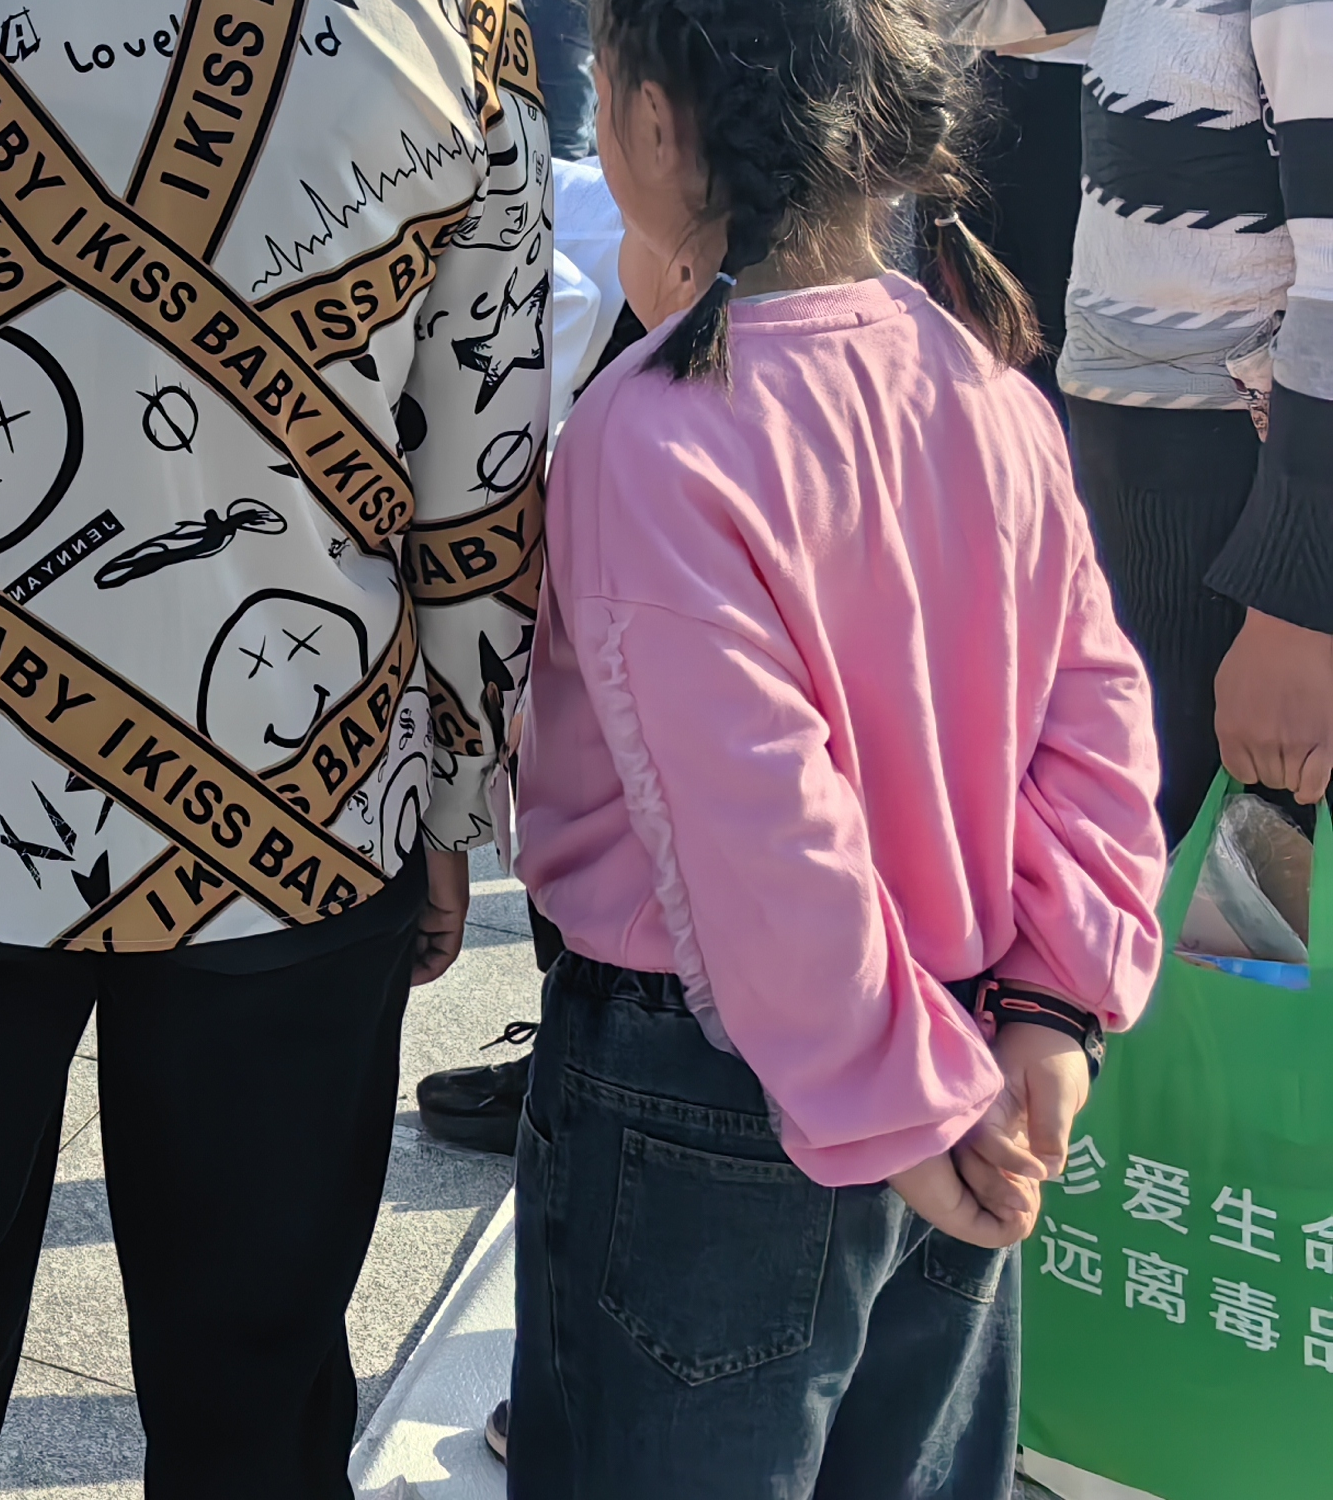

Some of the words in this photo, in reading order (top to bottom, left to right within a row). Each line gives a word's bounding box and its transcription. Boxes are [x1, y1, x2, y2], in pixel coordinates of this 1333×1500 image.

[171, 12, 265, 170] KISS
[73, 230, 199, 327] KISS
[191, 308, 320, 452] BABY
[322, 448, 408, 536] KISS
[289, 277, 379, 366] ISS
[122, 735, 251, 849] KISS
